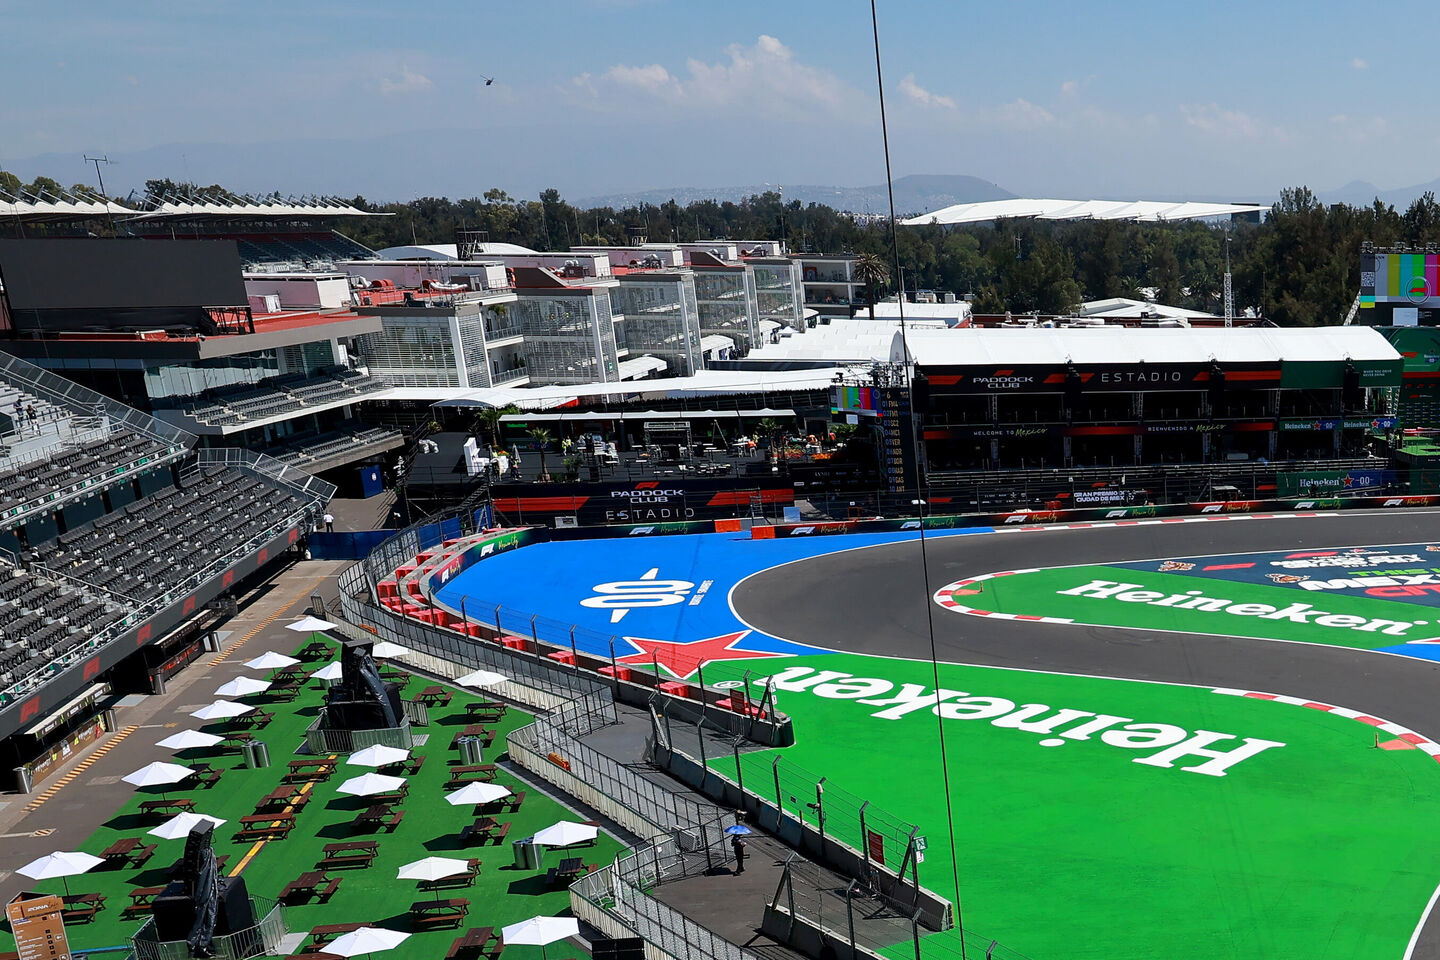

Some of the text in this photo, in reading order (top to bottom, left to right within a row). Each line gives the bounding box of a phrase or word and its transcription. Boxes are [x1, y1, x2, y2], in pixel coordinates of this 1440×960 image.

[973, 376, 1034, 384] PADDOCK
[1101, 371, 1181, 383] ESTADIO
[1284, 422, 1311, 430] Heineken
[1300, 477, 1339, 488] Heineken
[611, 489, 684, 498] PADDOCK
[606, 507, 695, 520] ESTADIO
[900, 521, 921, 529] F1
[629, 526, 655, 536] F1
[790, 526, 815, 535] F1
[480, 543, 495, 557] F1
[1348, 568, 1429, 576] THIS
[1058, 579, 1411, 637] Heineken
[754, 666, 1287, 777] Heineken
